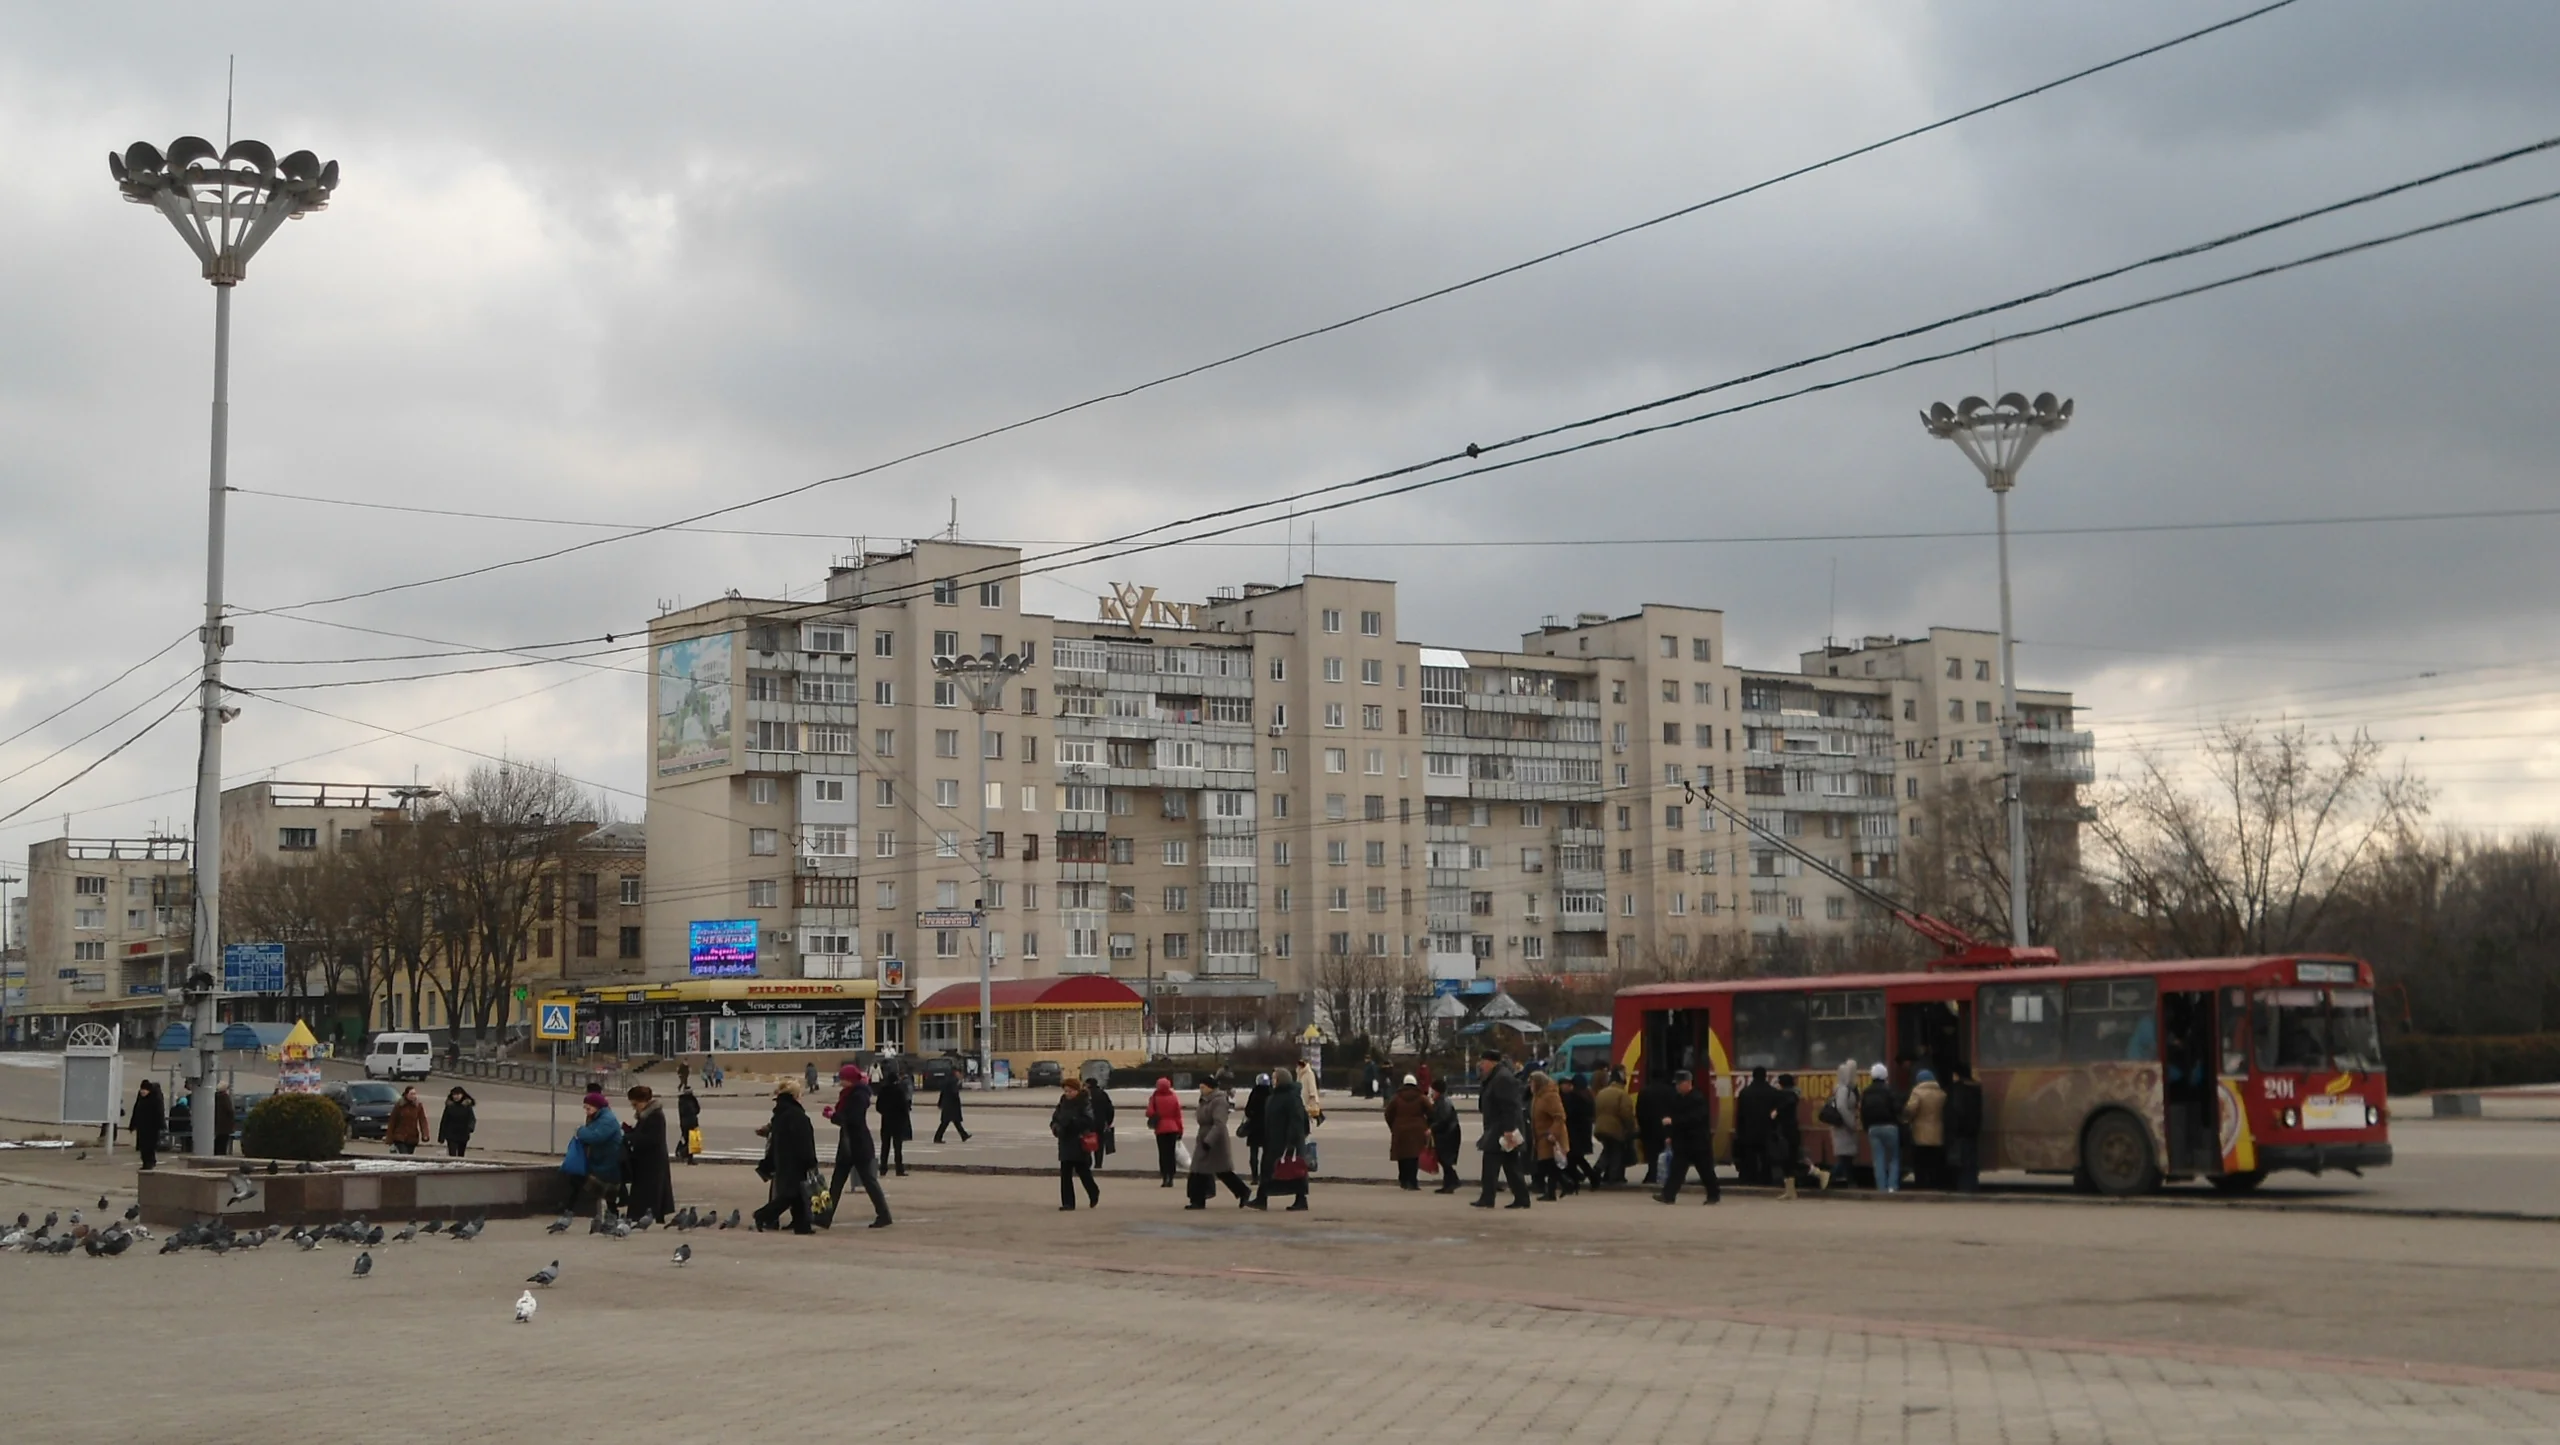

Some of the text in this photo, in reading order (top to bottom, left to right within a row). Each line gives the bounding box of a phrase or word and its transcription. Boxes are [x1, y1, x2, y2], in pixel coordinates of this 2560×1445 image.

[1098, 581, 1200, 635] KVINT
[696, 935, 751, 945] СНЕЖИНКА
[747, 1002, 776, 1012] Четыре
[2264, 1078, 2295, 1099] 201
